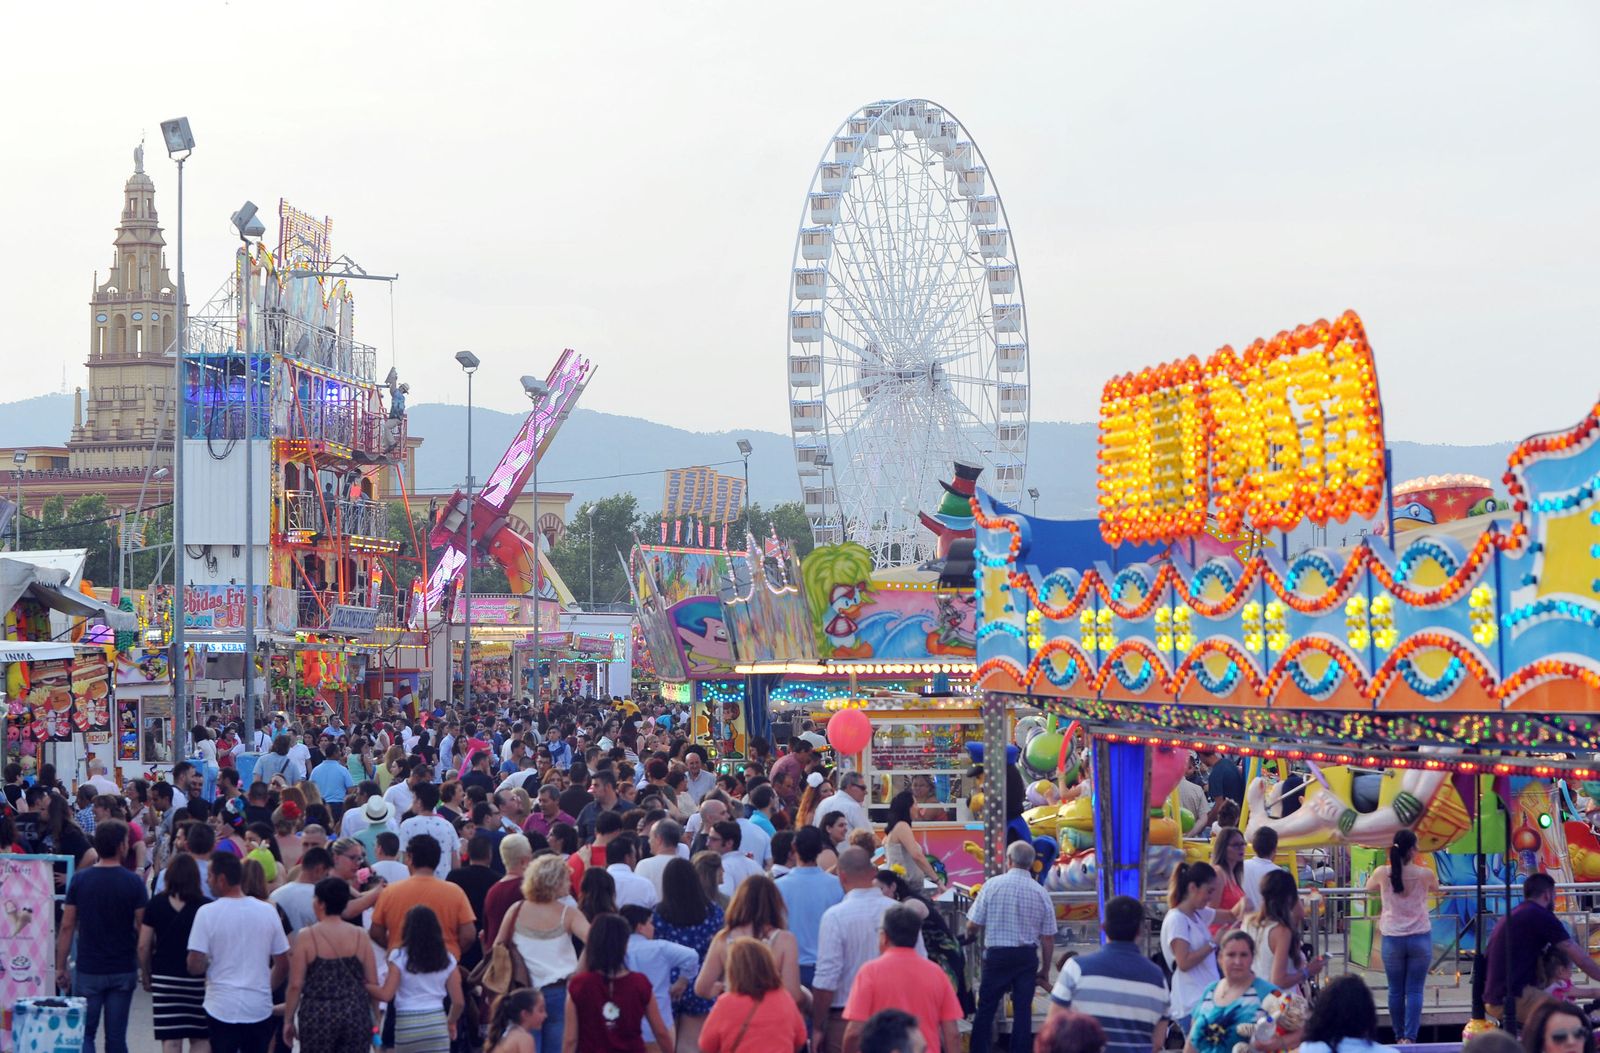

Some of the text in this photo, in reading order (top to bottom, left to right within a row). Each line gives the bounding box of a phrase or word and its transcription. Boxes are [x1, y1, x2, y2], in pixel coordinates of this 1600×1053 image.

[668, 472, 681, 514] RAGON
[183, 591, 222, 613] ebidas
[226, 588, 258, 606] Fris
[4, 652, 35, 661] INMA
